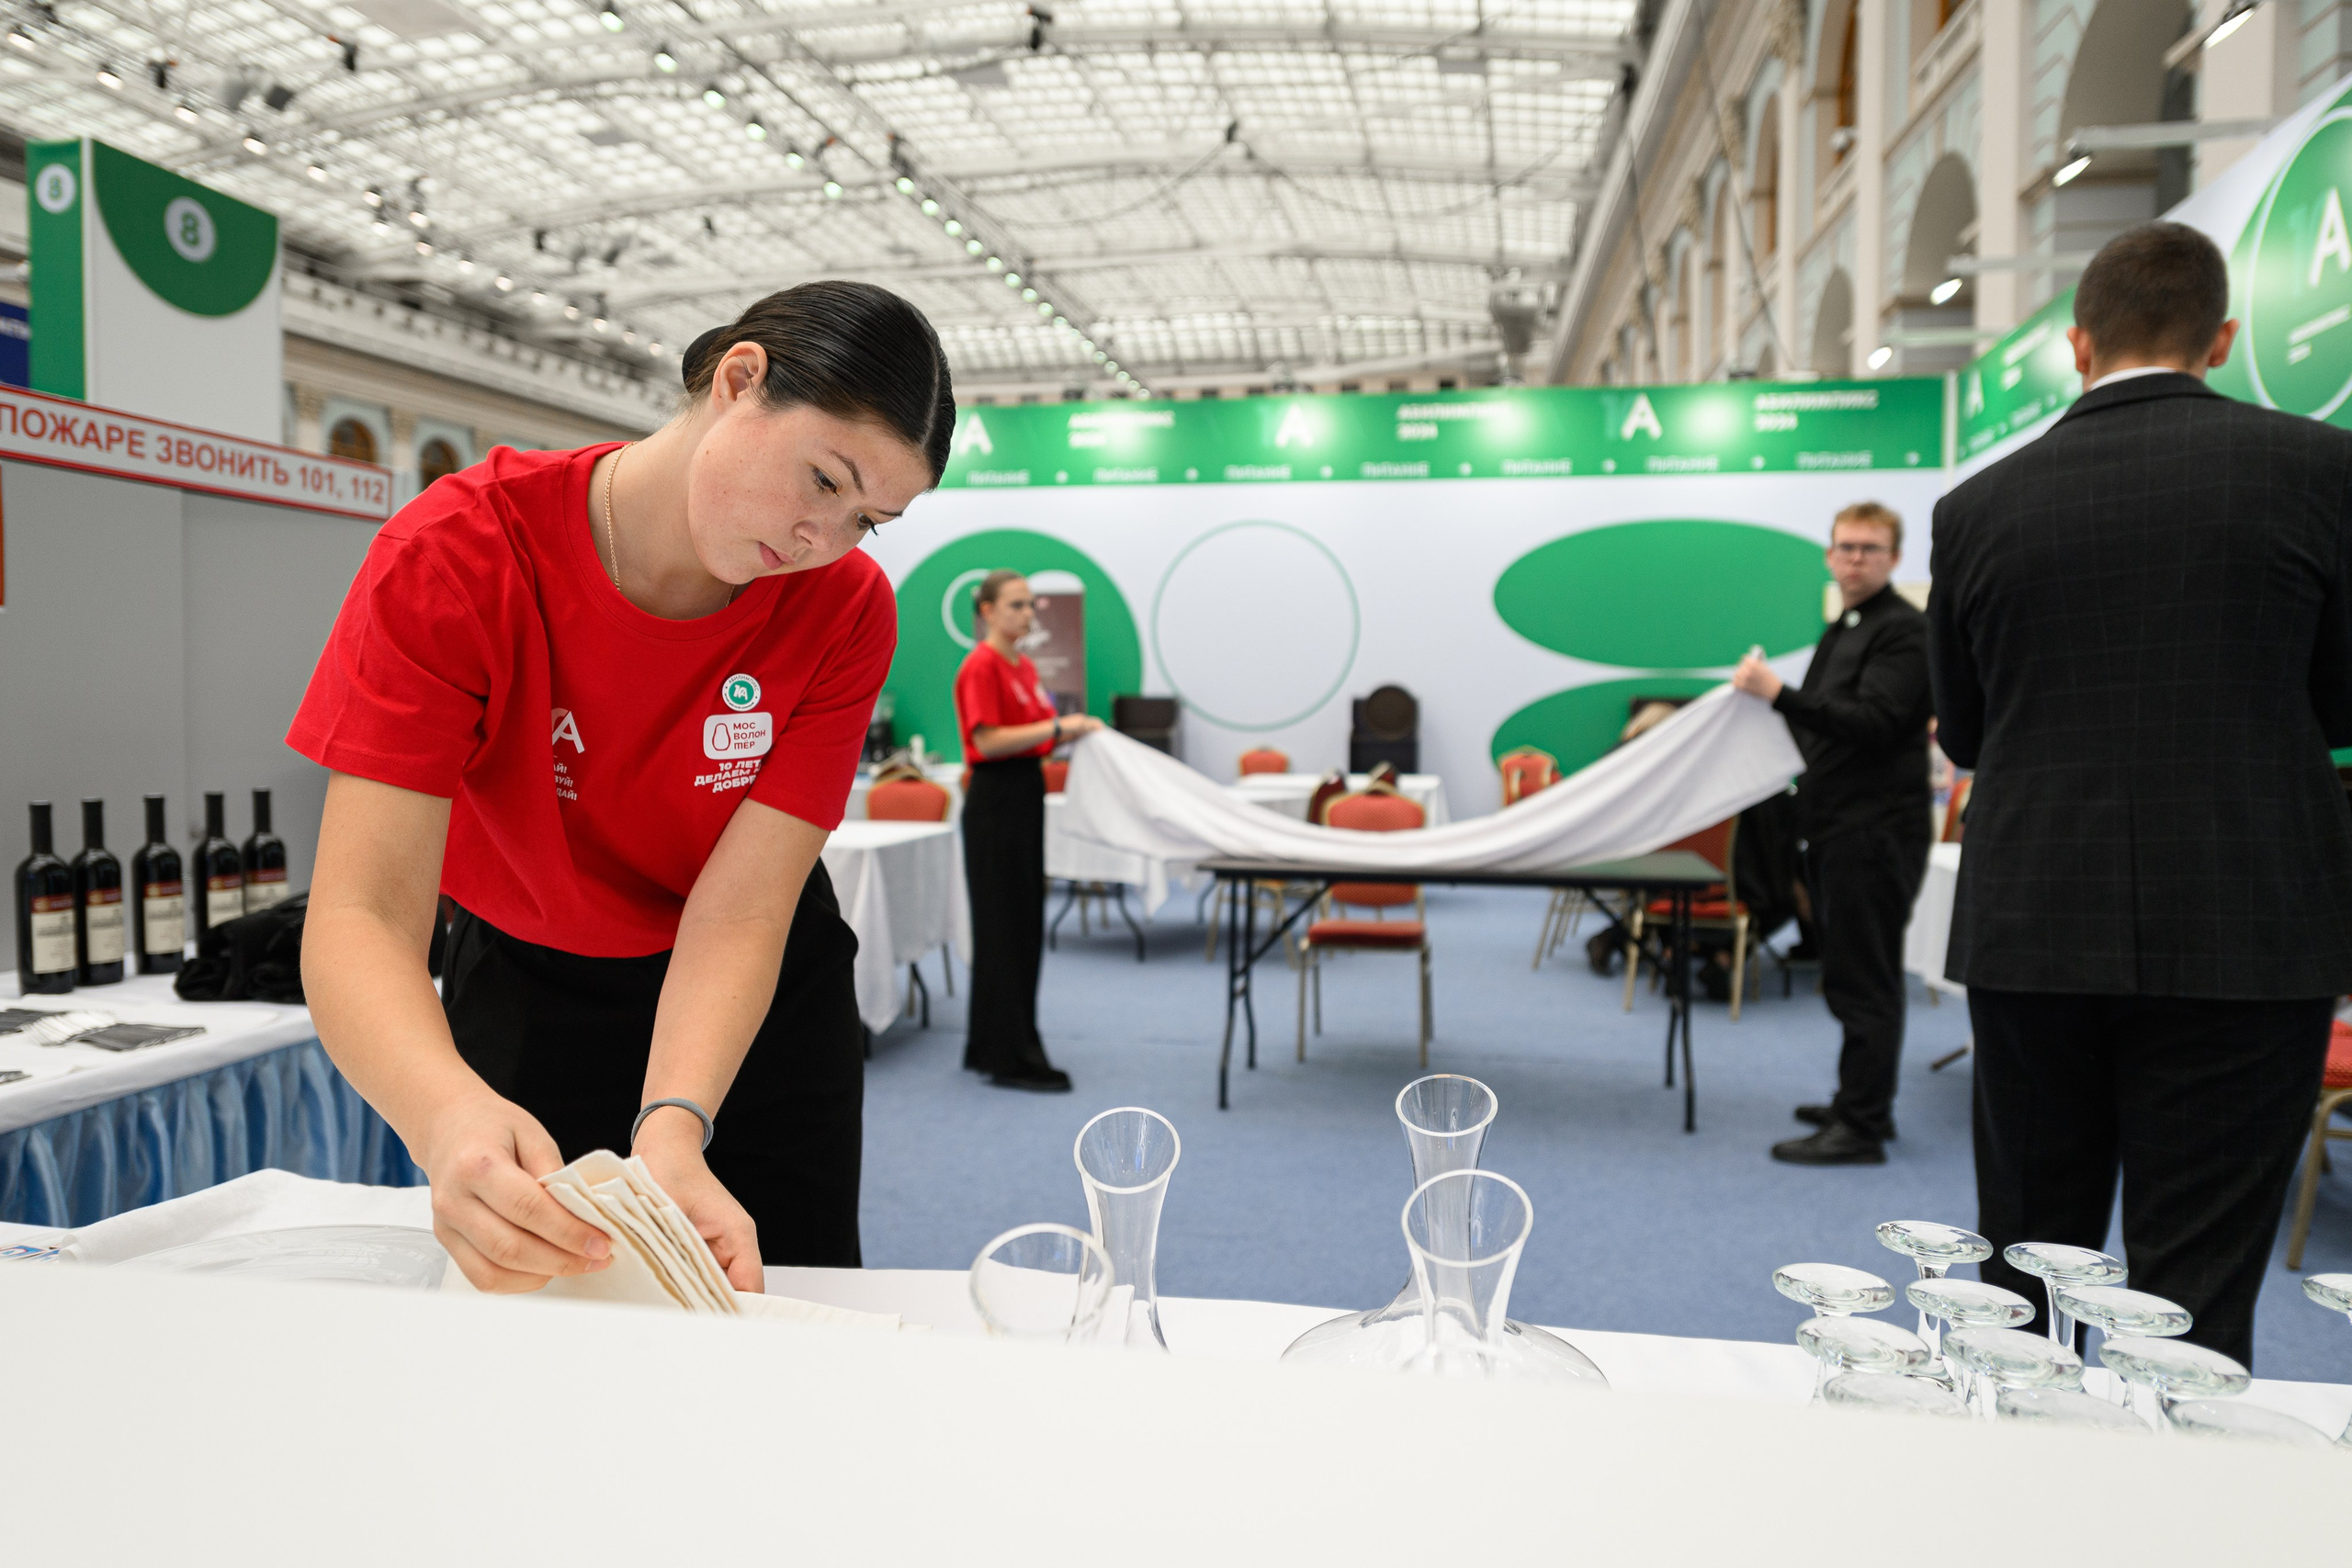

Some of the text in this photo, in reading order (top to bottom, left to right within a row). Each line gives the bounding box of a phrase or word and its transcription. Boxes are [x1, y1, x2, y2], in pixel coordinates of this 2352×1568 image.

[181, 212, 200, 247] 8
[0, 403, 384, 504] ПОЖАРЕ ЗВОНИТЬ 101, 112
[733, 722, 756, 730] МОС
[733, 729, 766, 740] ВОЛОН
[718, 759, 762, 772] 10 ЛЕТ
[694, 769, 751, 787] ДЕЛАЕМ
